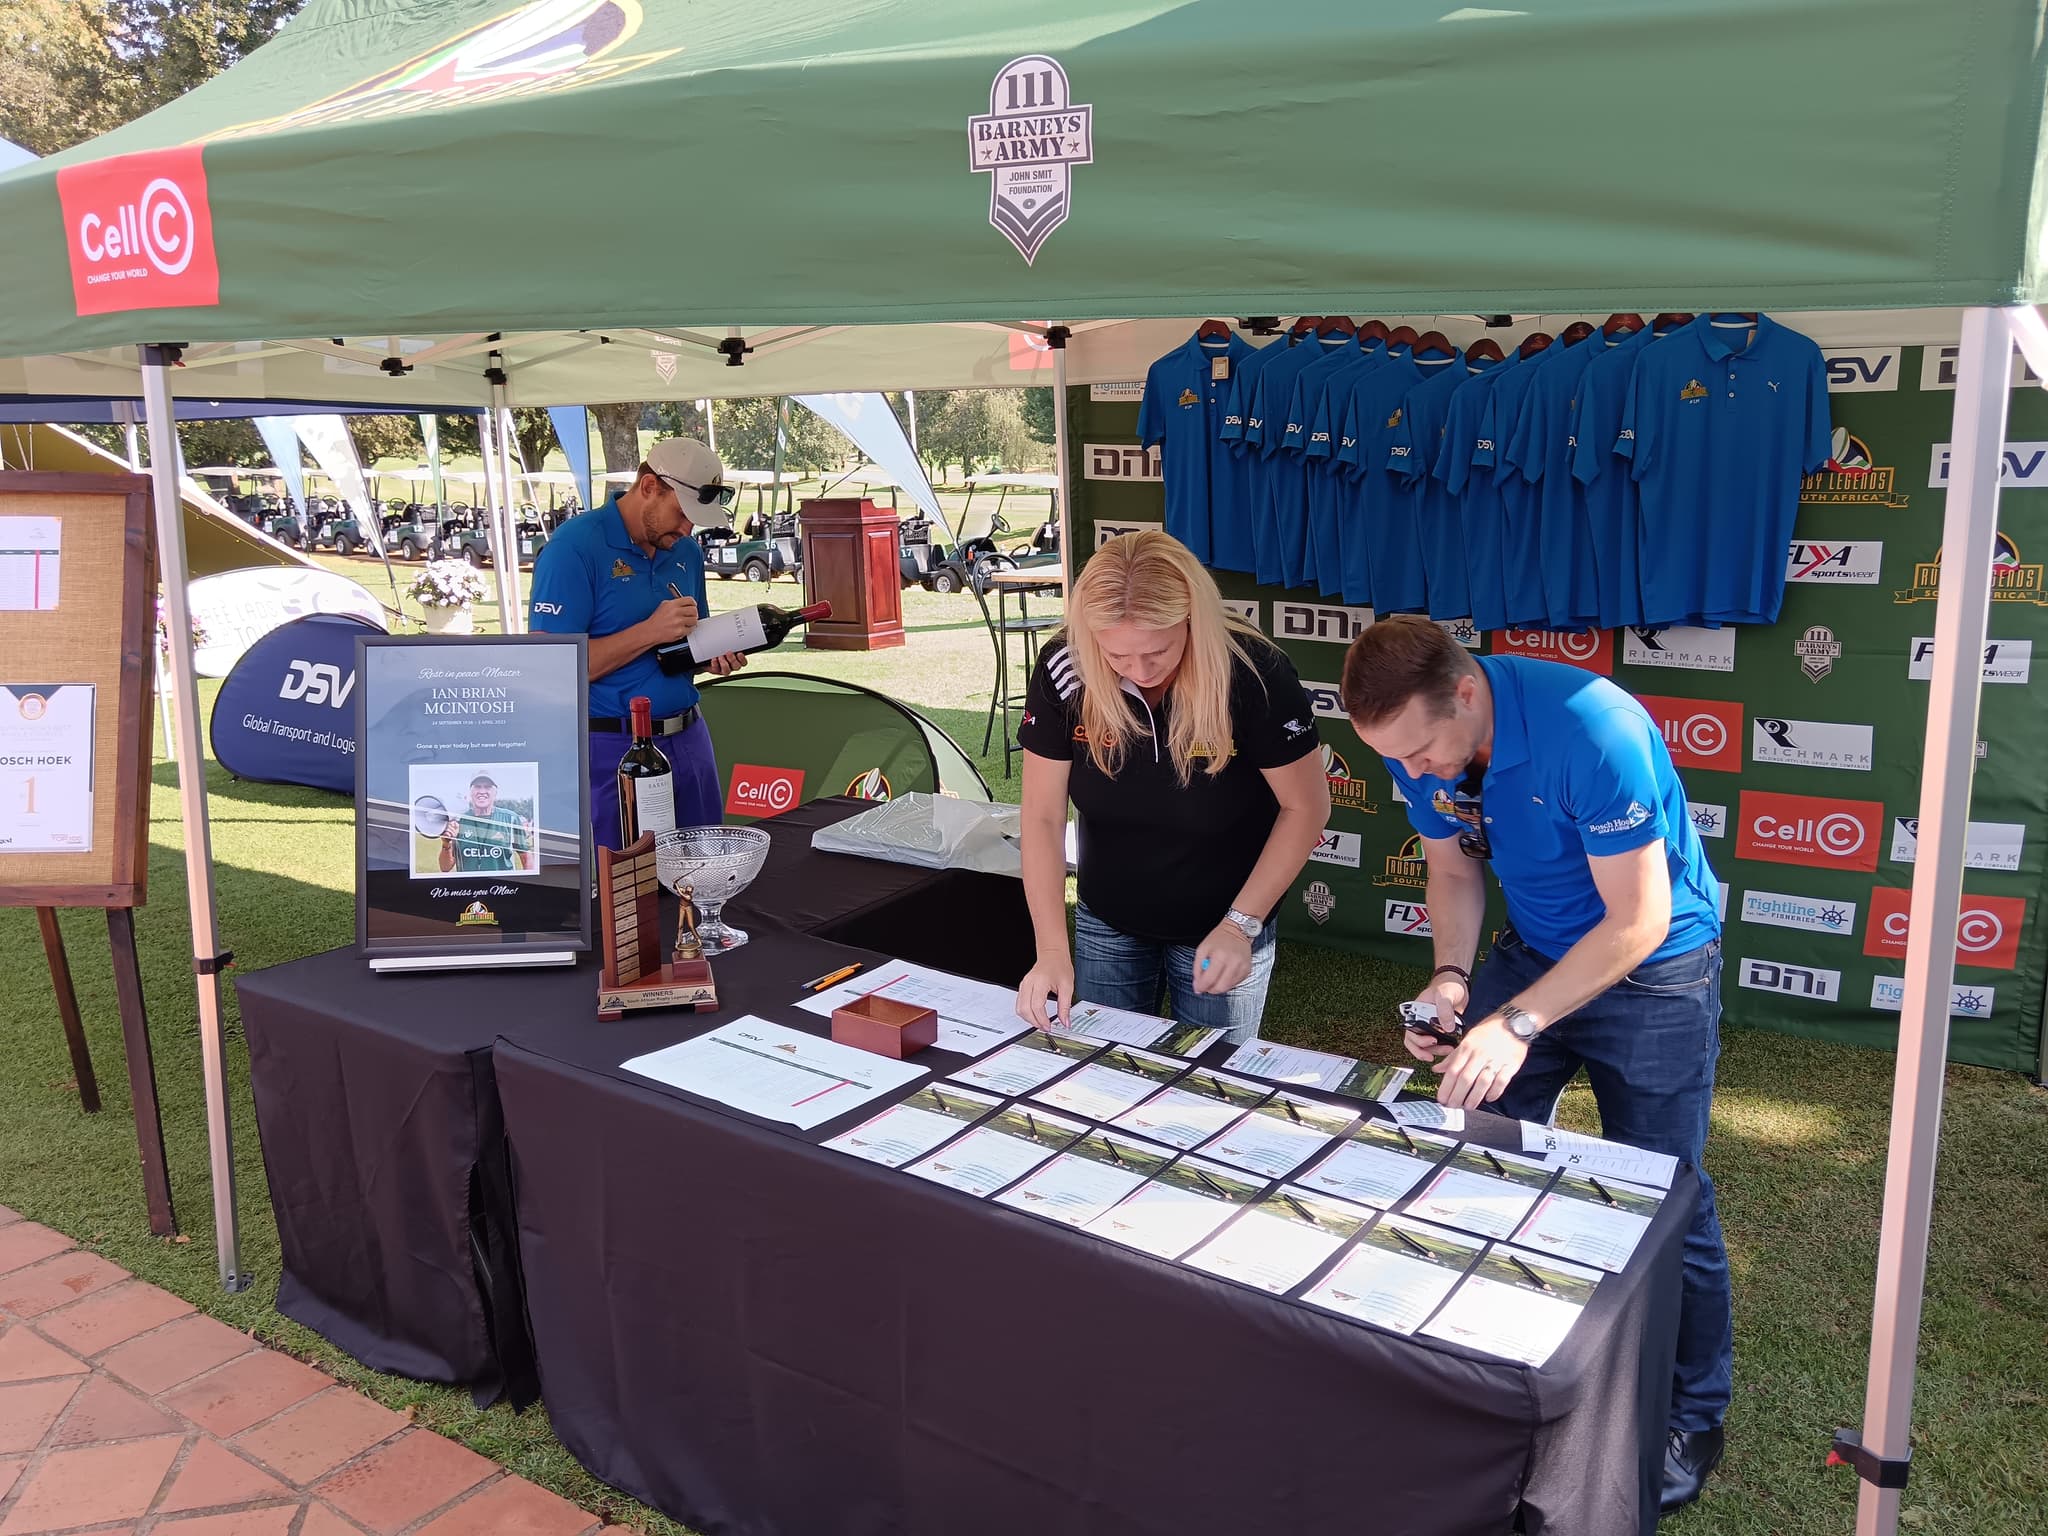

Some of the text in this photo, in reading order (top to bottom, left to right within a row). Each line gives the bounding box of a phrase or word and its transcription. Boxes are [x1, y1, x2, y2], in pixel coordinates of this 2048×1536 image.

[1005, 70, 1055, 110] 111
[978, 115, 1081, 141] BARNEYS
[994, 136, 1065, 161] ARMY
[1009, 169, 1052, 182] JOHN SMIT
[1009, 184, 1052, 195] FOUNDATION
[87, 268, 148, 284] CHANGE YOUR WORLD
[1248, 418, 1262, 428] SV
[1342, 437, 1355, 447] SV
[1391, 447, 1411, 457] DSV
[1829, 472, 1886, 490] LEGENDS
[1811, 570, 1876, 579] sportswear
[534, 602, 562, 616] DSV
[1629, 650, 1732, 664] RICHMARK
[417, 666, 521, 680] Rest in peace Master
[280, 659, 356, 709] DSV
[432, 687, 506, 699] IAN BRIAN
[424, 701, 514, 715] MCINTOSH
[243, 713, 356, 755] Global Transport and Logis
[453, 742, 470, 751] today
[0, 756, 72, 766] OSCH HOEK
[1758, 747, 1868, 762] RICHMARK
[24, 776, 40, 814] 1
[1331, 780, 1361, 797] GENDS
[1589, 821, 1613, 833] Bosch
[1613, 816, 1636, 828] Hoek
[1393, 877, 1427, 887] SOUTH
[430, 885, 519, 898] We miss you Mac!
[1748, 897, 1817, 917] Tightline
[1771, 913, 1816, 923] FISHERIES
[642, 990, 674, 998] WINNERS
[738, 1032, 764, 1041] DSV
